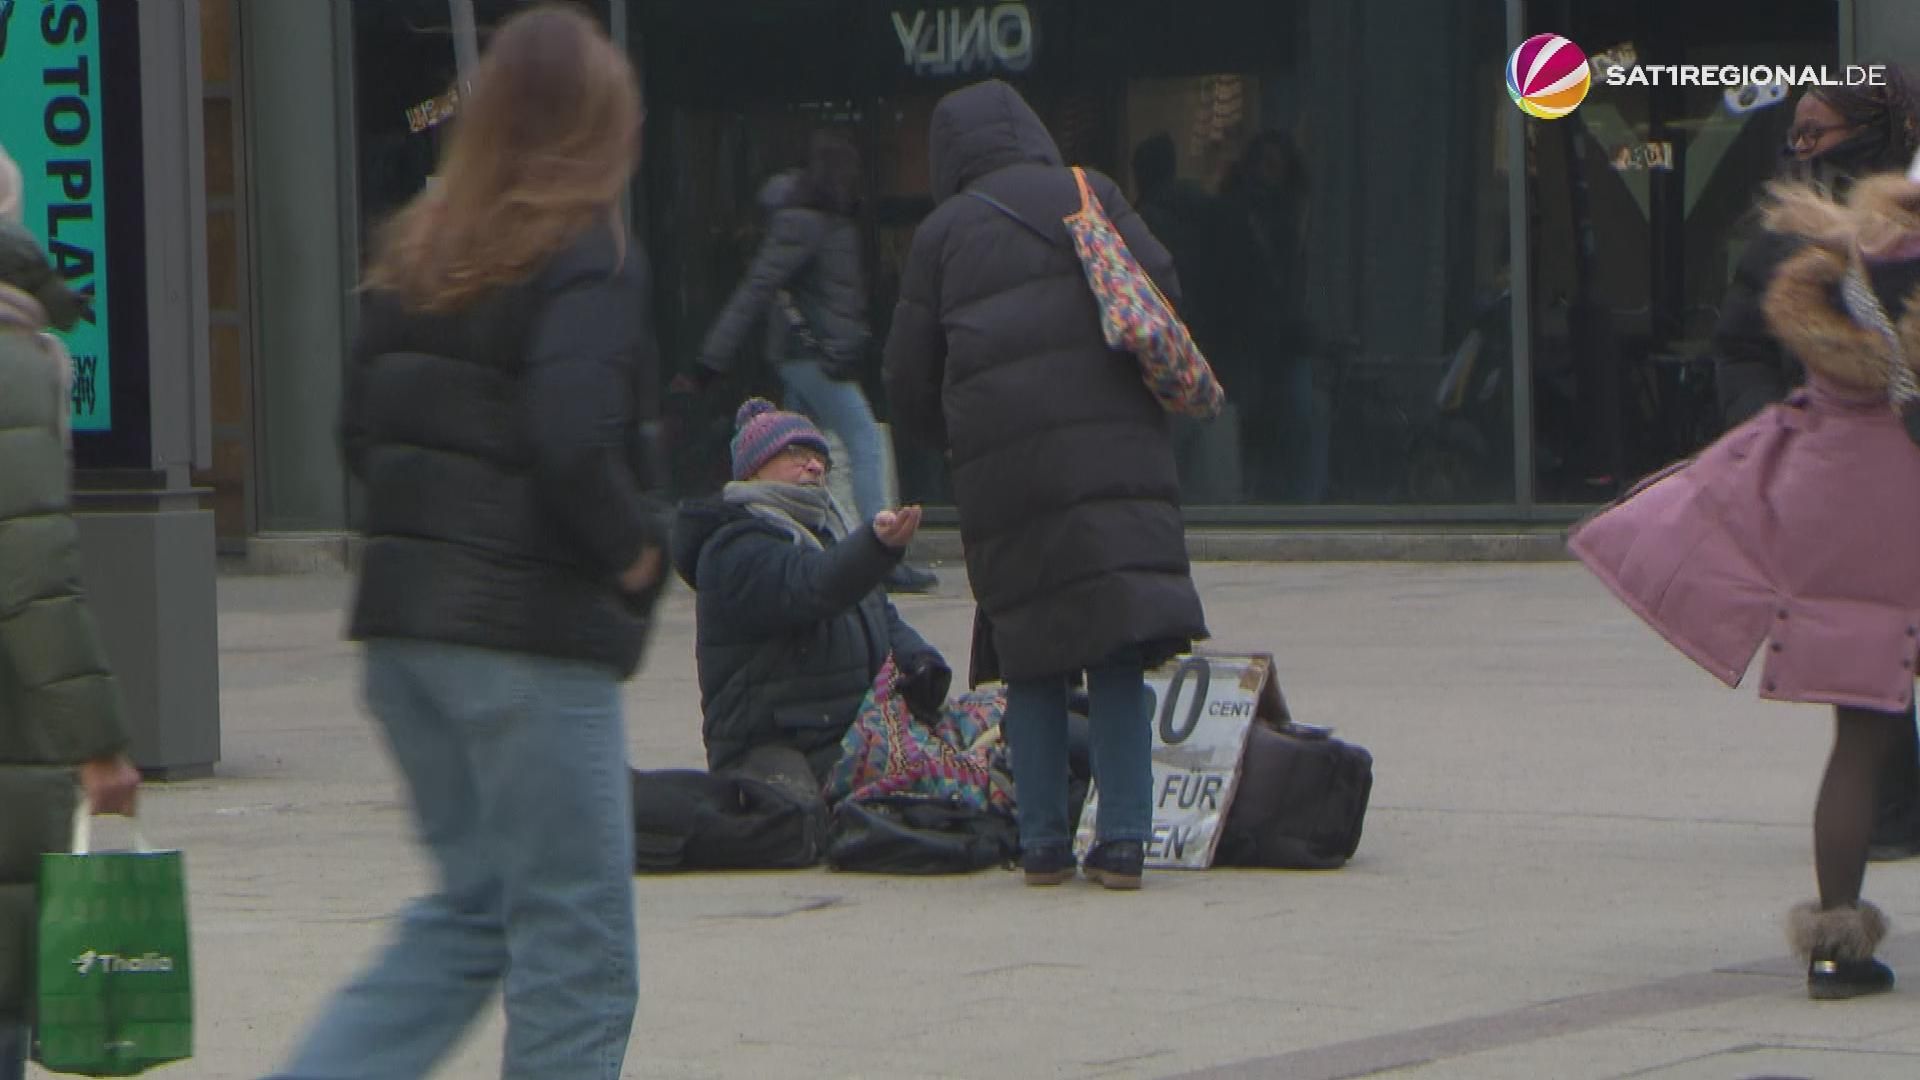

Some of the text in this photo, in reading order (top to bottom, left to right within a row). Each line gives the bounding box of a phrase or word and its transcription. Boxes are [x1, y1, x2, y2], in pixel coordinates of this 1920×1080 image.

[1143, 657, 1254, 745] 0 CENT
[1158, 766, 1223, 810] FÜR
